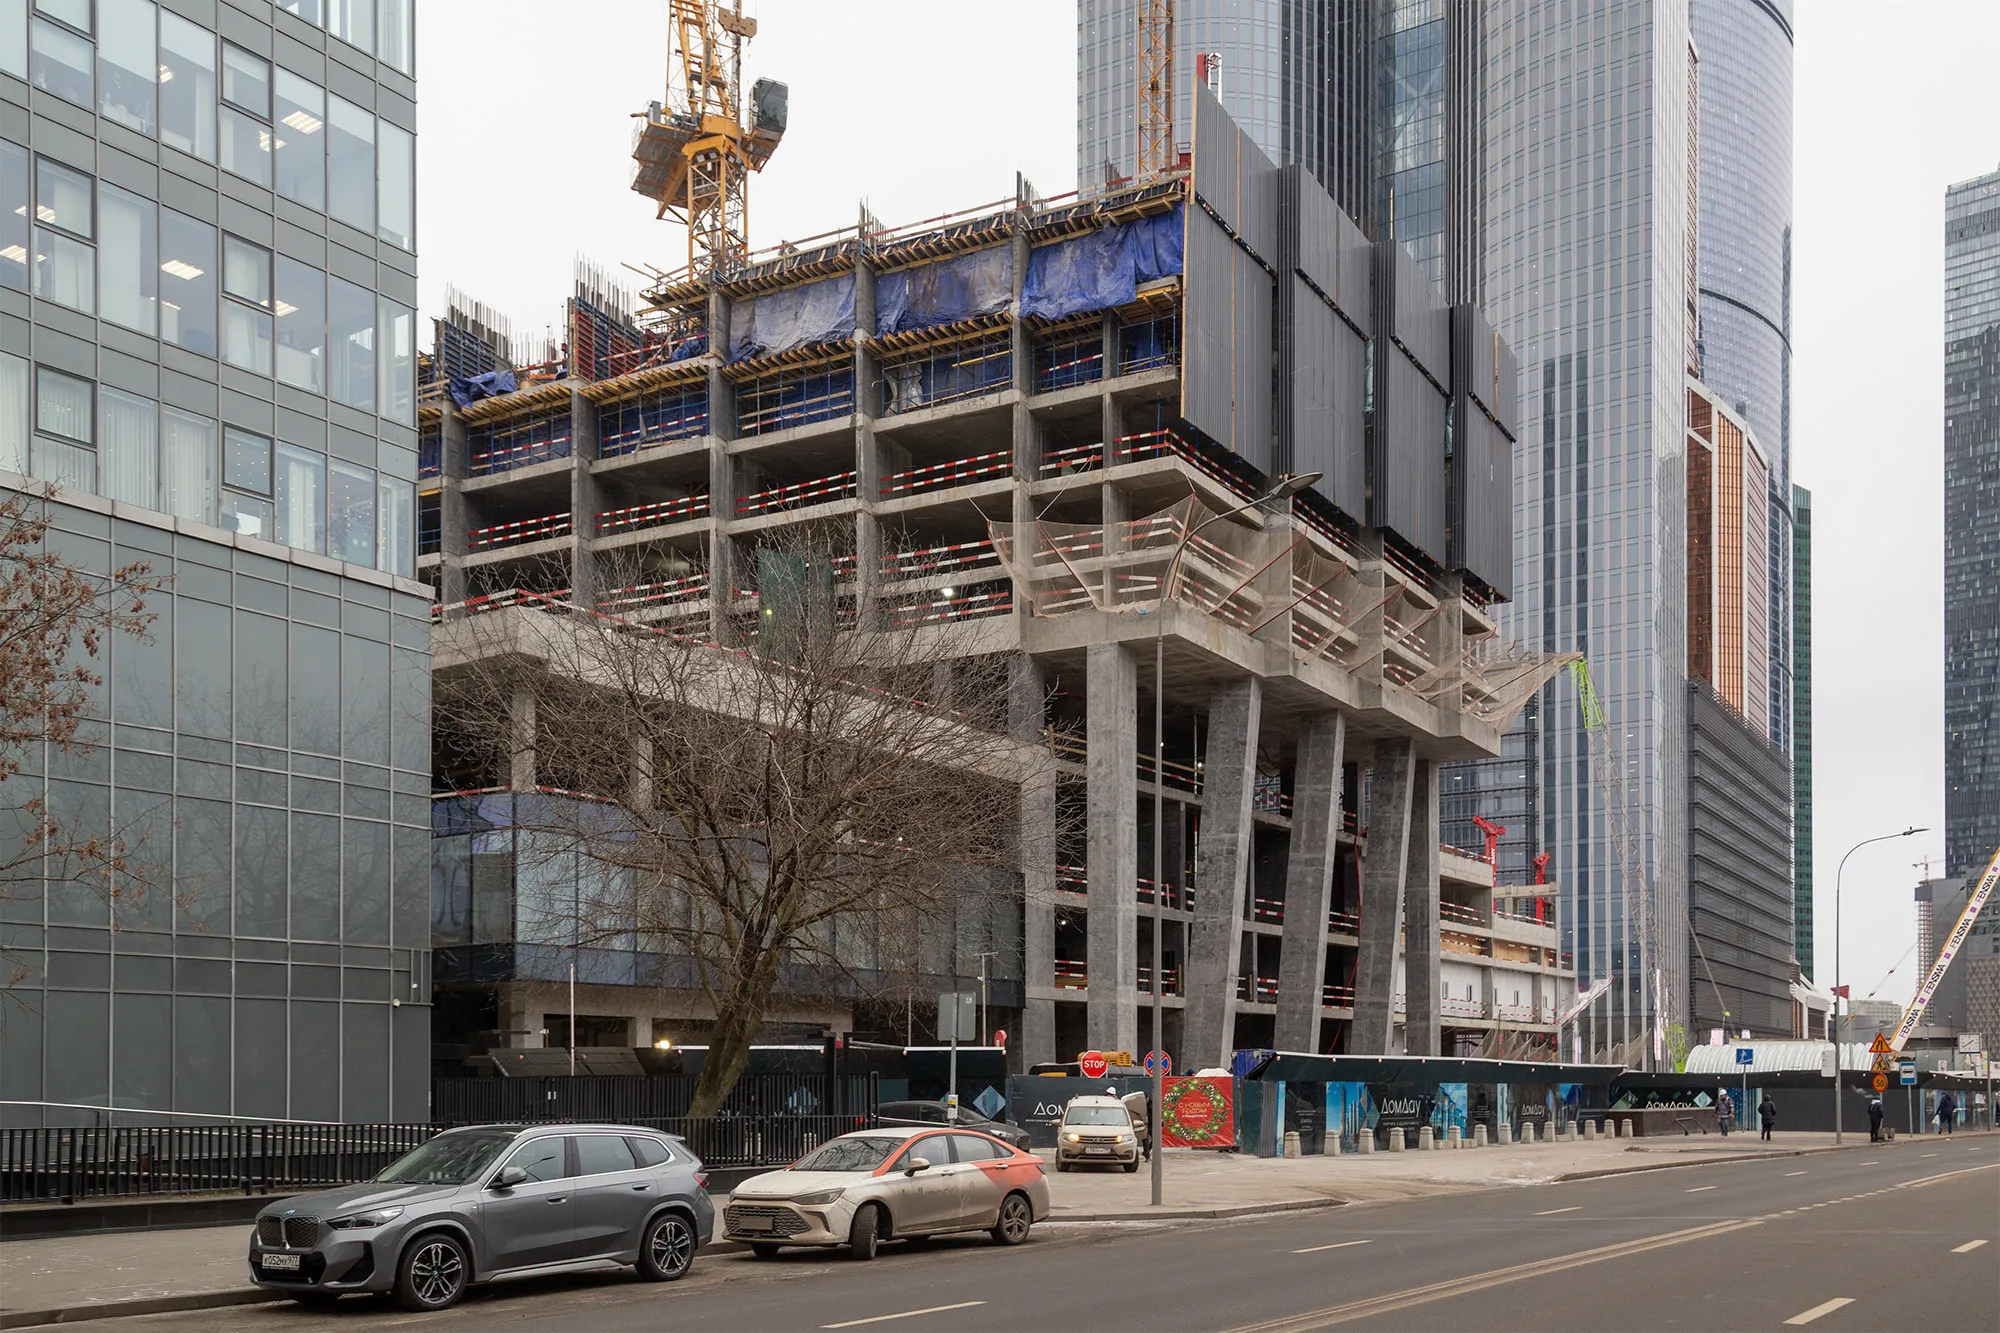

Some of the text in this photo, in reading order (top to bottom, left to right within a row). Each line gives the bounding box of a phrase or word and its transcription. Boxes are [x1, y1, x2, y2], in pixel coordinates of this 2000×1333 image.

[1975, 874, 1997, 903] FENSMA
[1949, 918, 1972, 948] FENSMA
[1923, 964, 1946, 994] FENSMA
[1900, 1009, 1921, 1038] FENSMA
[1084, 1060, 1104, 1068] STOP
